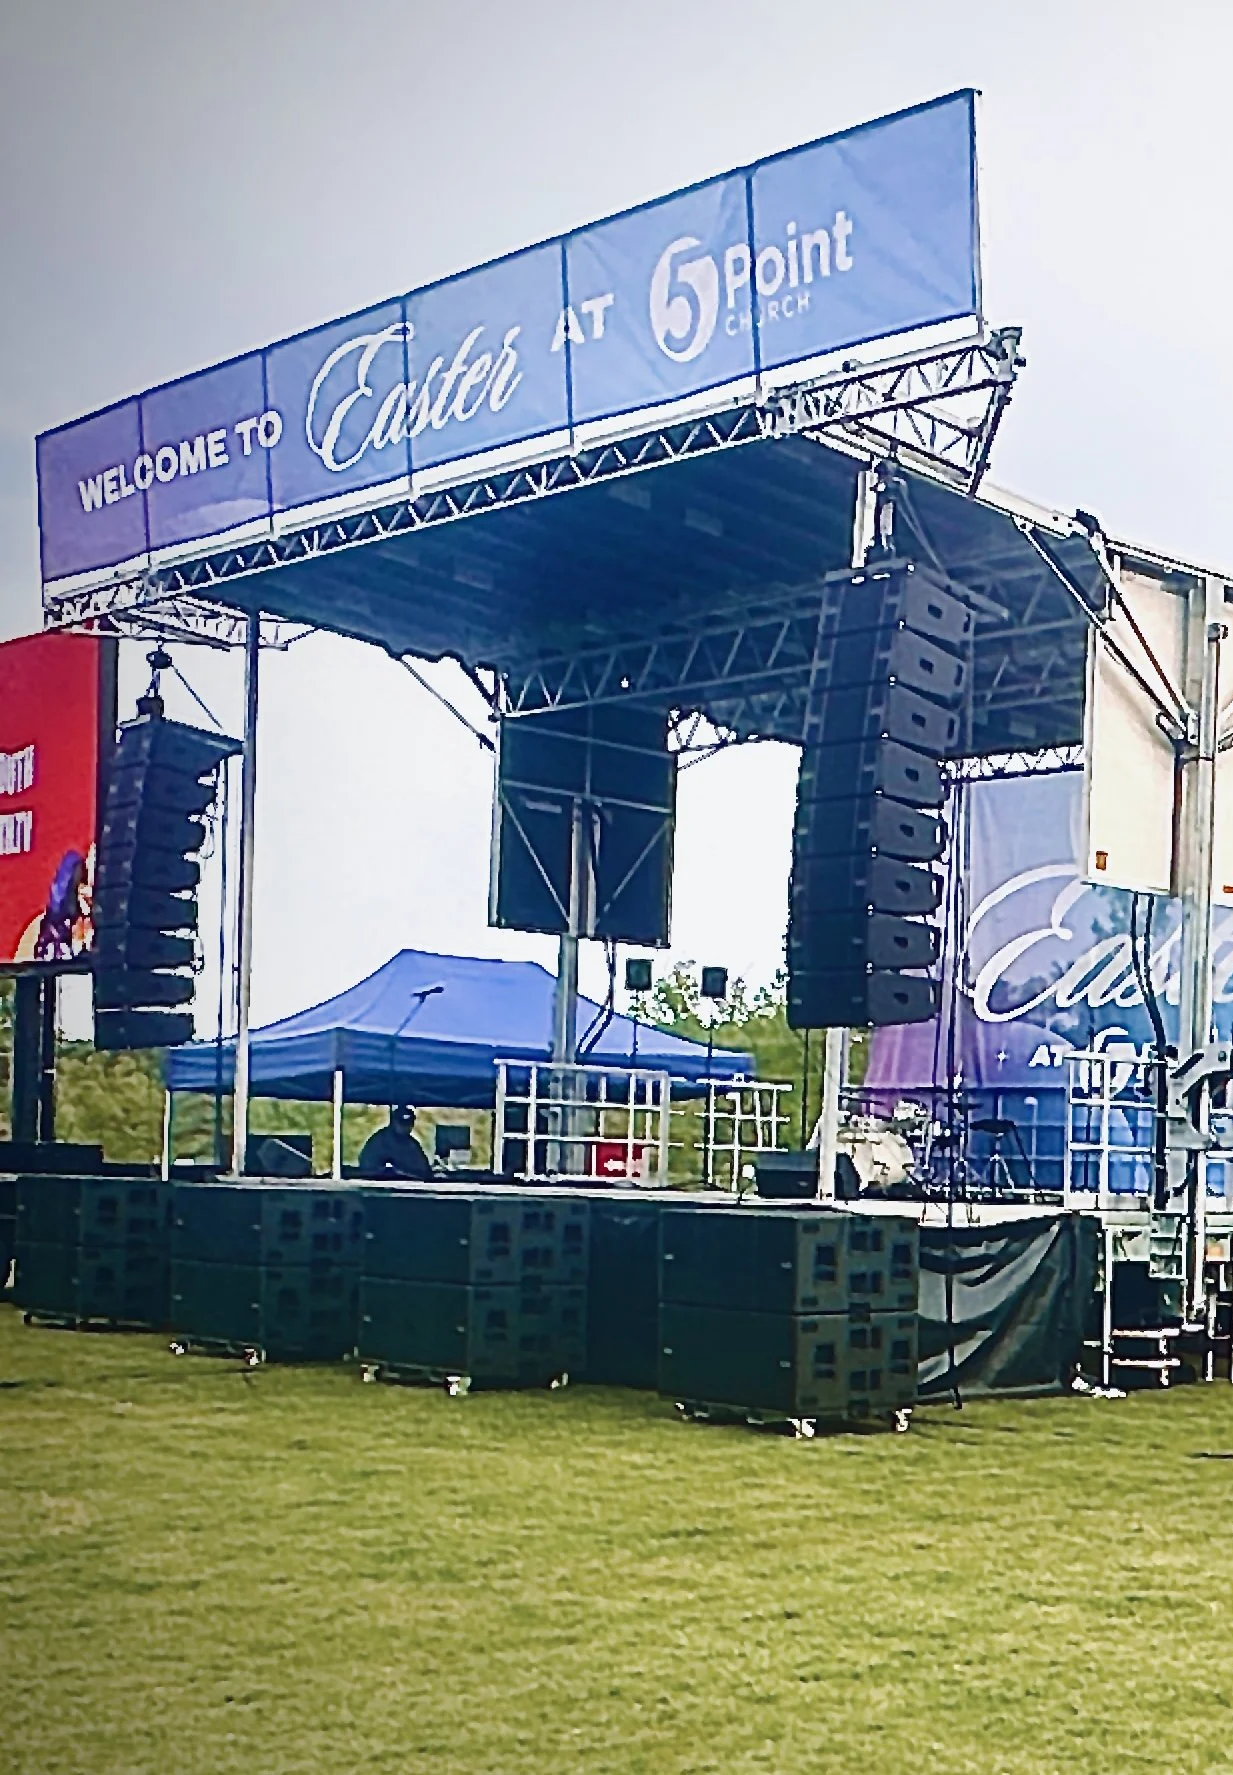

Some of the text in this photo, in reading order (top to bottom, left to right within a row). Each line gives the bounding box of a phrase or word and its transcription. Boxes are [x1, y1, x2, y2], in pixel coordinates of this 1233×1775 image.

[78, 429, 230, 512] WELCOME
[234, 410, 283, 456] TO
[306, 321, 524, 472] Easter
[550, 292, 615, 352] AT
[724, 210, 853, 309] Point
